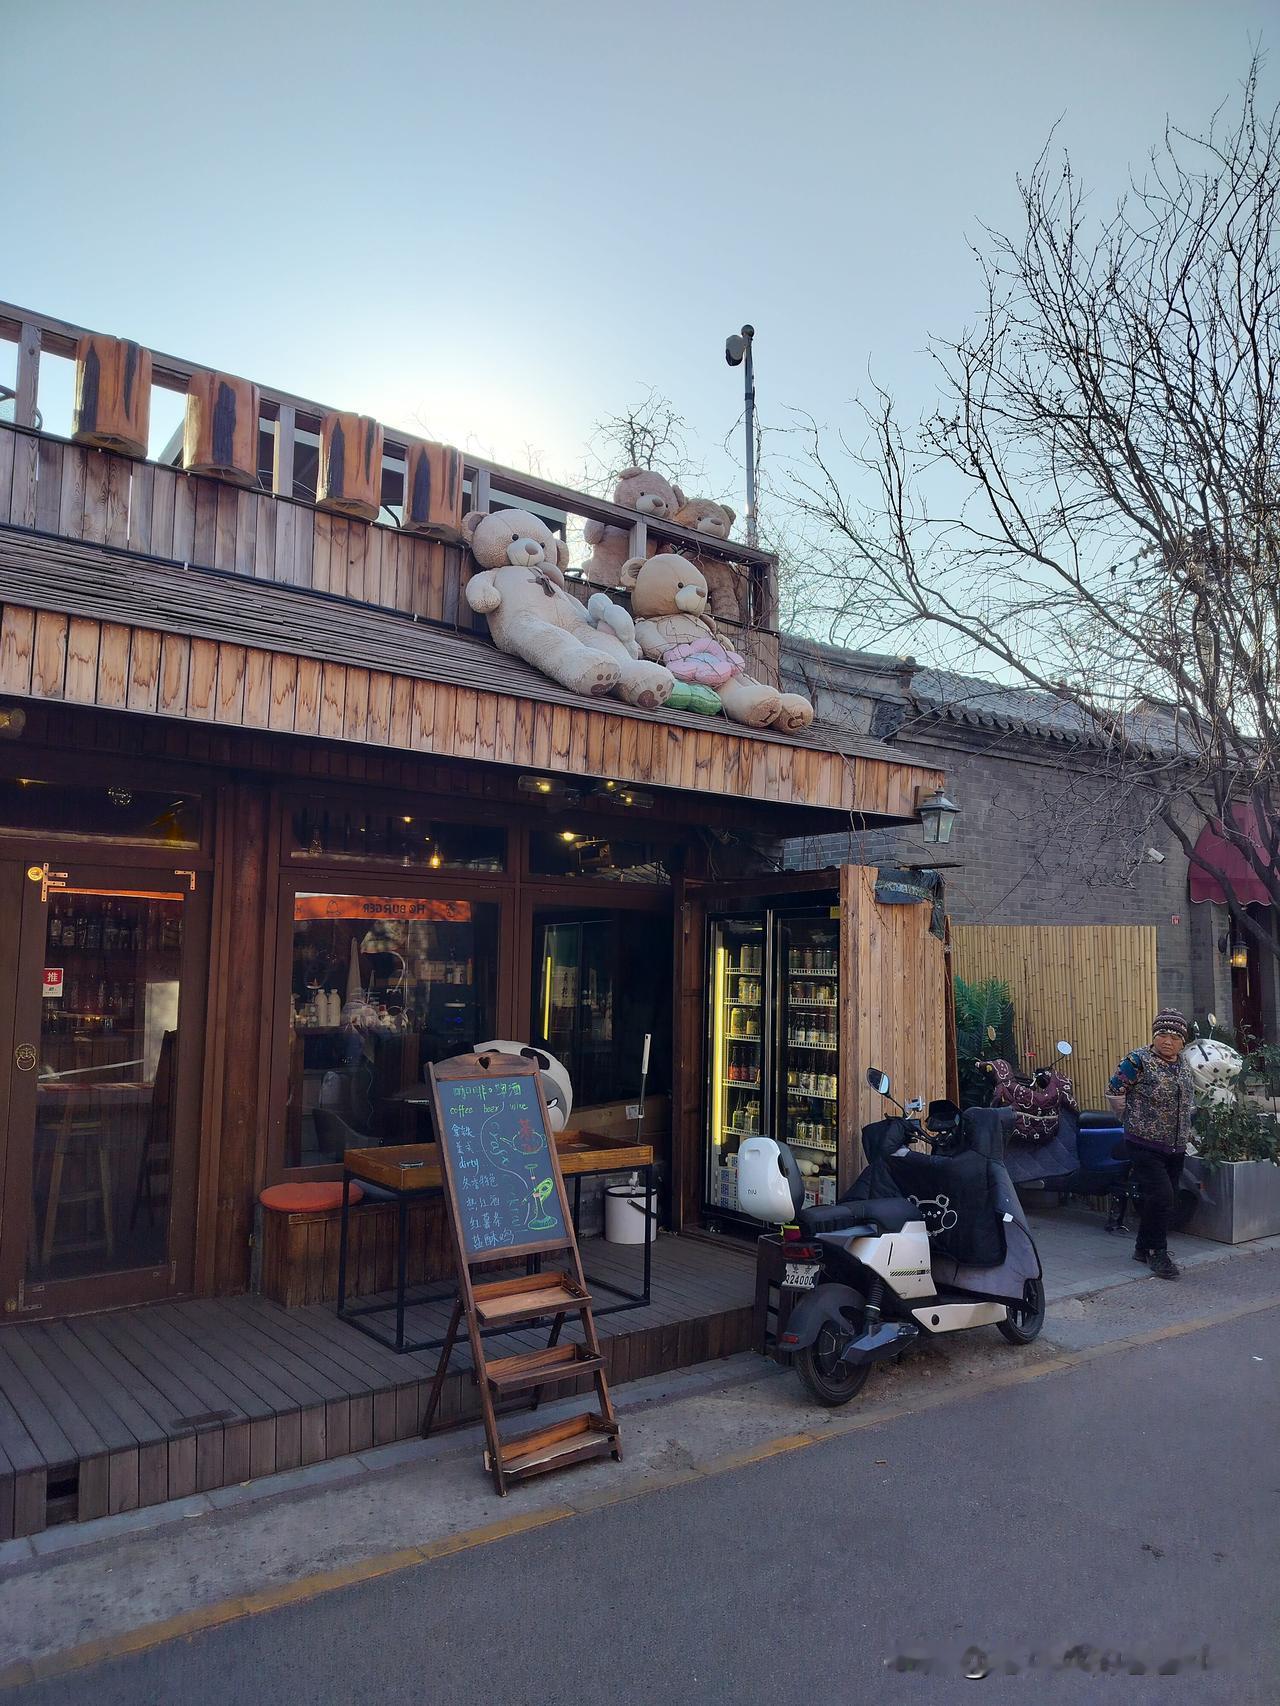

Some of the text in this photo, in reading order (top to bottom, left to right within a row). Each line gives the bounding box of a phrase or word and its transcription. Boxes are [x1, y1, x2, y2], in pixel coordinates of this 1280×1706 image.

[47, 971, 58, 982] 推
[450, 1104, 474, 1118] coffee
[458, 1156, 480, 1177] dirty
